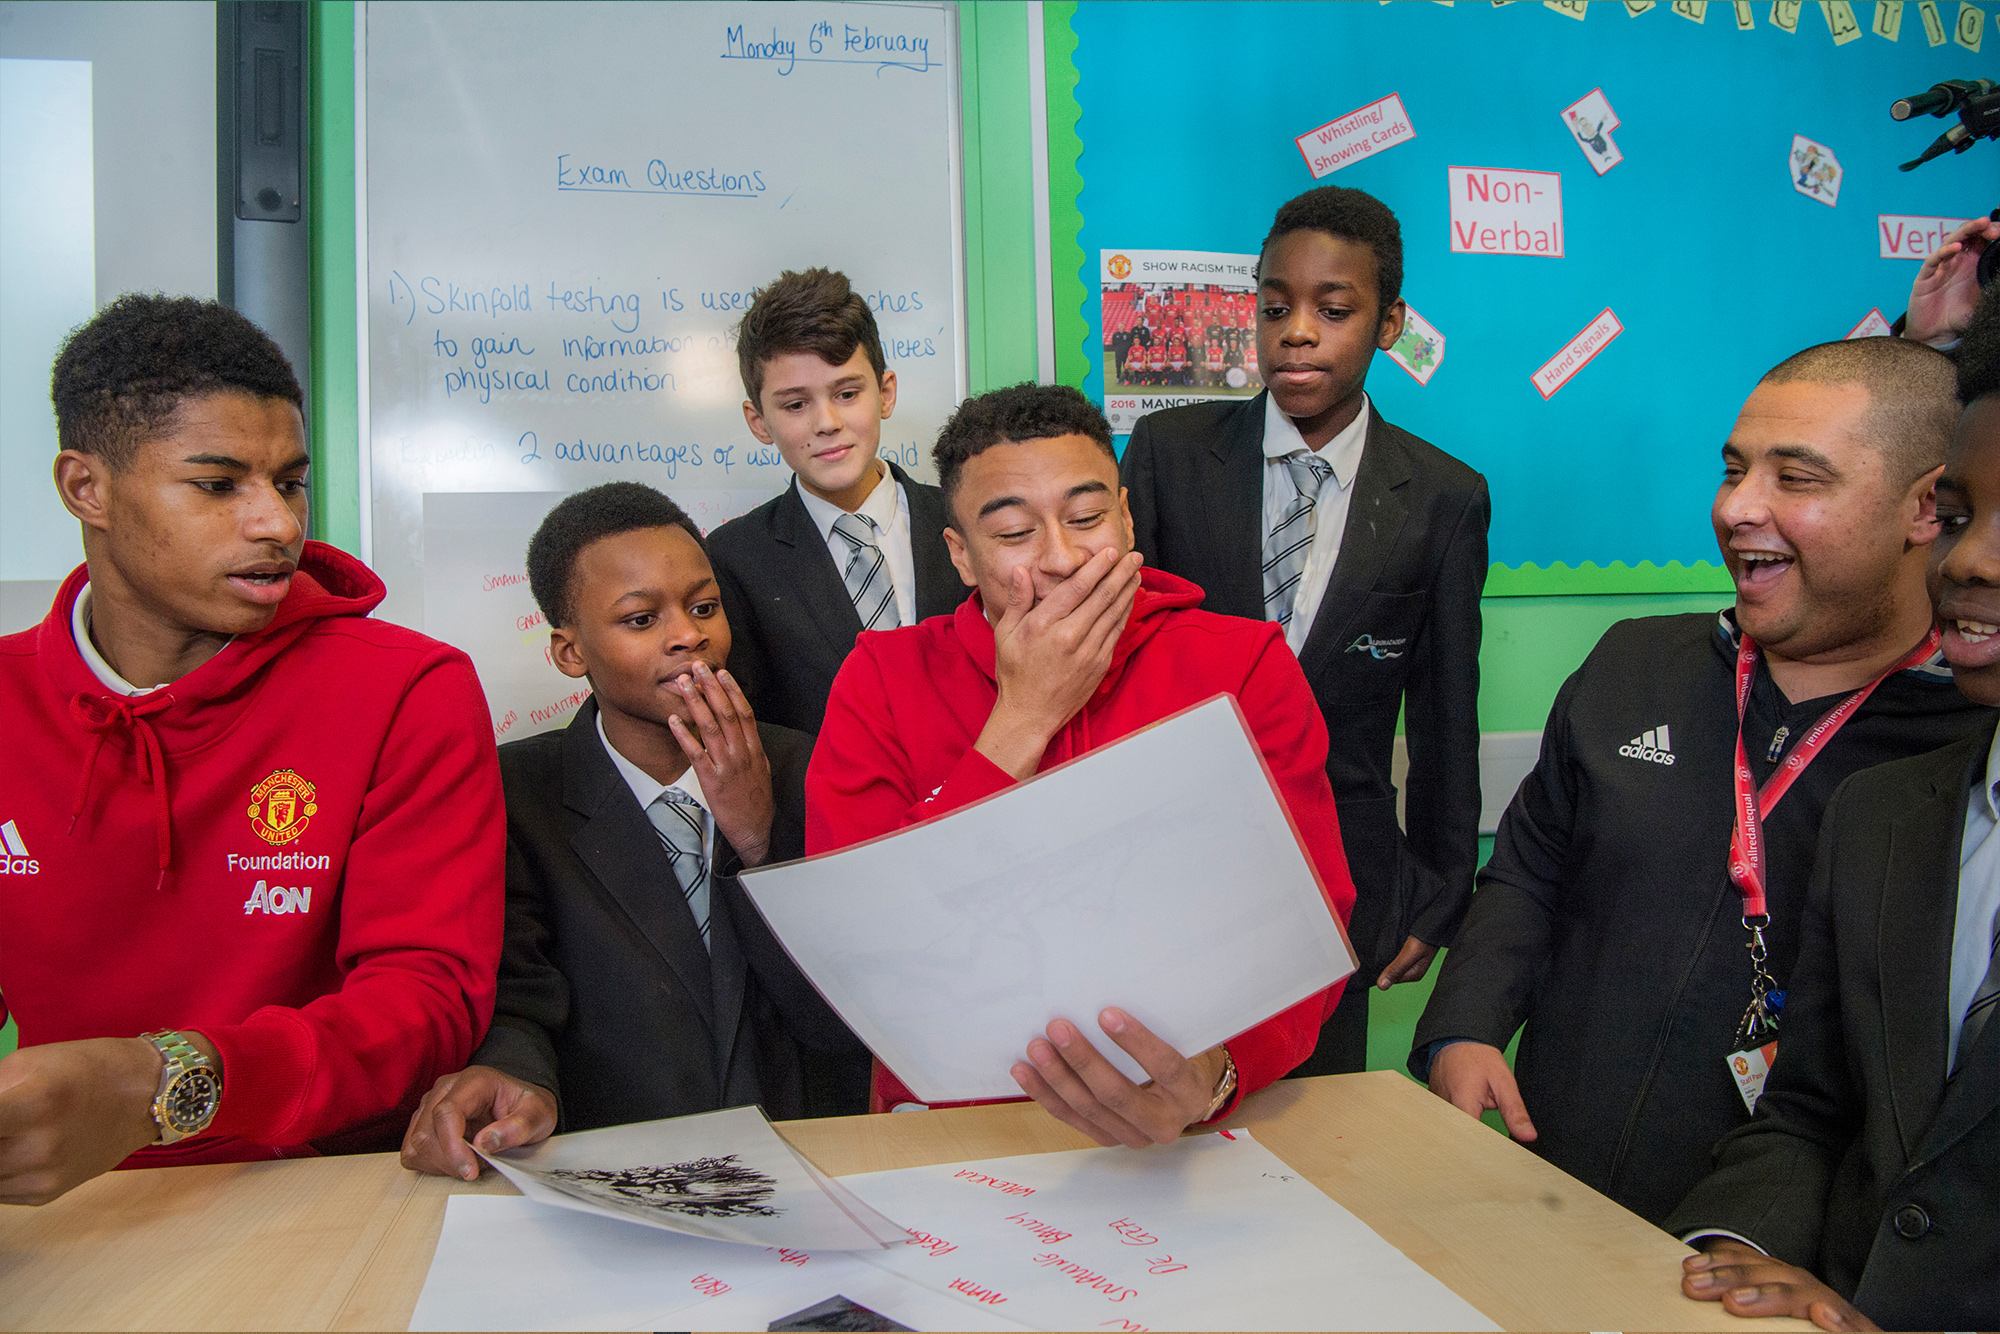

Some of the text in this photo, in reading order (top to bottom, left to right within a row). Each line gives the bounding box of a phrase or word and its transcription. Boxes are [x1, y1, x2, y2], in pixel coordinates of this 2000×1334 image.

[727, 24, 795, 76] Monday
[844, 24, 929, 75] February
[1317, 104, 1384, 145] Whistling/
[1314, 122, 1407, 171] Showing Cards
[558, 154, 767, 192] Exam Questions
[1466, 173, 1543, 204] Non-
[1454, 220, 1558, 252] Verbal
[1142, 262, 1178, 272] SHOW
[1181, 263, 1224, 274] RACISM
[1227, 265, 1248, 275] THE
[421, 276, 532, 319] Skinfold
[547, 277, 640, 333] testing
[657, 277, 684, 311] is
[867, 290, 923, 313] ches
[434, 329, 458, 357] to
[471, 333, 535, 369] gain
[563, 334, 694, 361] information
[1544, 323, 1610, 384] Hand Signals
[445, 367, 676, 404] physical condition
[1111, 400, 1136, 409] 2016
[519, 431, 541, 465] 2
[555, 440, 703, 480] advantages
[713, 445, 735, 474] of
[1618, 744, 1676, 766] adidas
[255, 774, 310, 799] MANCHESTER
[260, 826, 299, 841] UNITED
[1746, 793, 1758, 869] #allredallequal
[227, 851, 330, 871] Foundation
[243, 880, 312, 915] AON
[948, 1278, 1008, 1304] MATA
